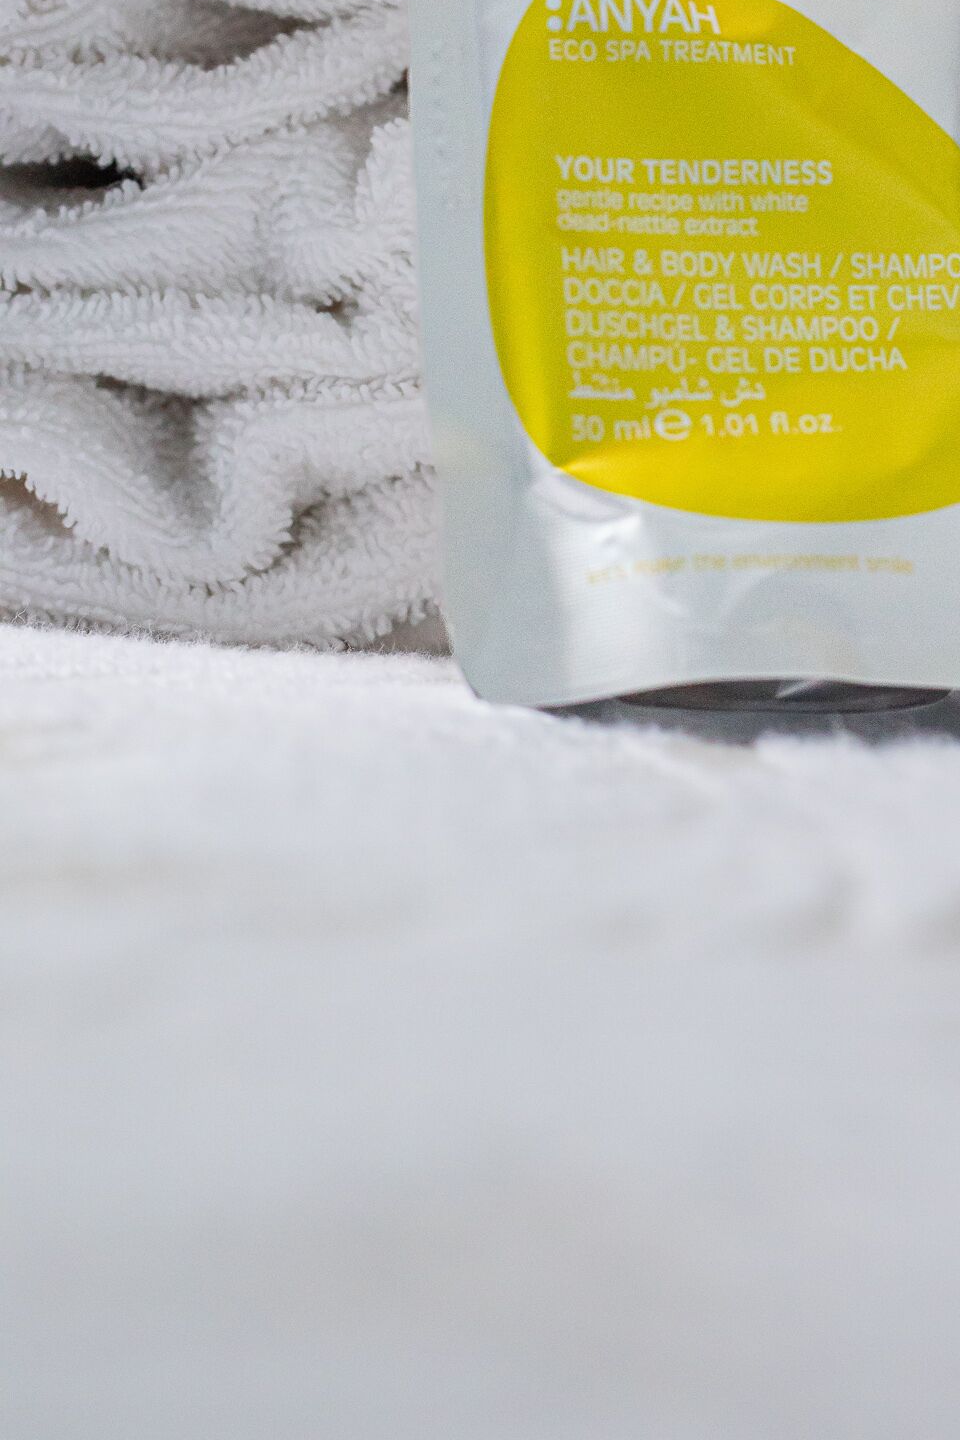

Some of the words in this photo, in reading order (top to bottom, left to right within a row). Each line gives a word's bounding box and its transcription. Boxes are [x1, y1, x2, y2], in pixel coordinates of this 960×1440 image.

[548, 38, 598, 61] ECO
[605, 39, 651, 62] SPA
[659, 39, 796, 66] TREATMENT
[555, 155, 634, 184] YOUR
[643, 159, 833, 186] TENDERNESS
[561, 247, 625, 273] HAIR
[632, 248, 652, 275] &
[660, 249, 734, 278] BODY
[742, 252, 821, 279] WASH
[829, 253, 843, 278] /
[563, 276, 665, 307] DOCCIA
[672, 281, 686, 308] /
[694, 283, 743, 310] GEL
[751, 284, 841, 311] CORPS
[848, 284, 879, 311] ET
[566, 308, 708, 341] DUSCHGEL
[715, 314, 735, 342] &
[742, 315, 879, 343] SHAMPOO
[886, 317, 900, 342] /
[706, 346, 758, 374] GEL
[764, 347, 803, 374] DE
[810, 346, 909, 373] DUCHA
[614, 415, 650, 441] ml
[701, 412, 759, 438] 1.01
